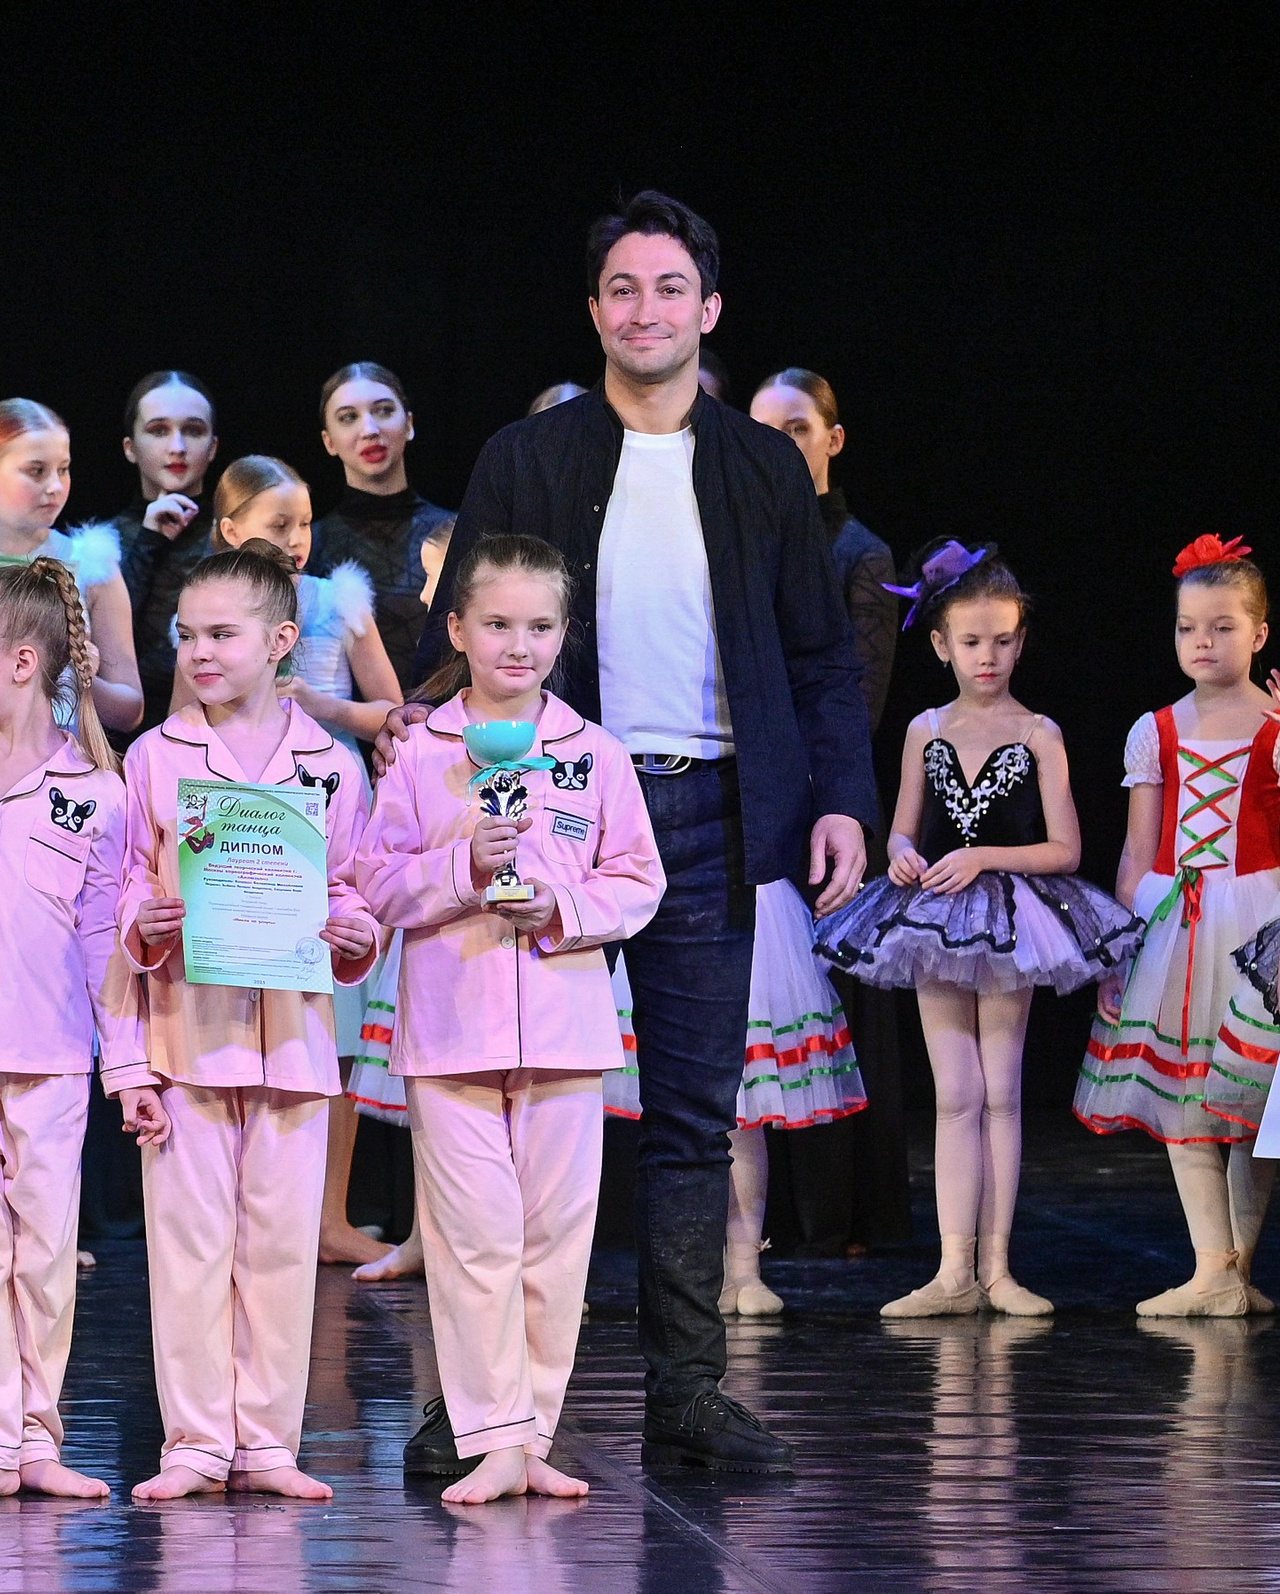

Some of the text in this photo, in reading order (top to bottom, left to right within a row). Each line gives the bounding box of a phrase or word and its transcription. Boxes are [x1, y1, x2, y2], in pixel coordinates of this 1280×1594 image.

[217, 795, 286, 821] Диалог
[221, 821, 282, 838] танца
[220, 841, 283, 856] ДИПЛОМ
